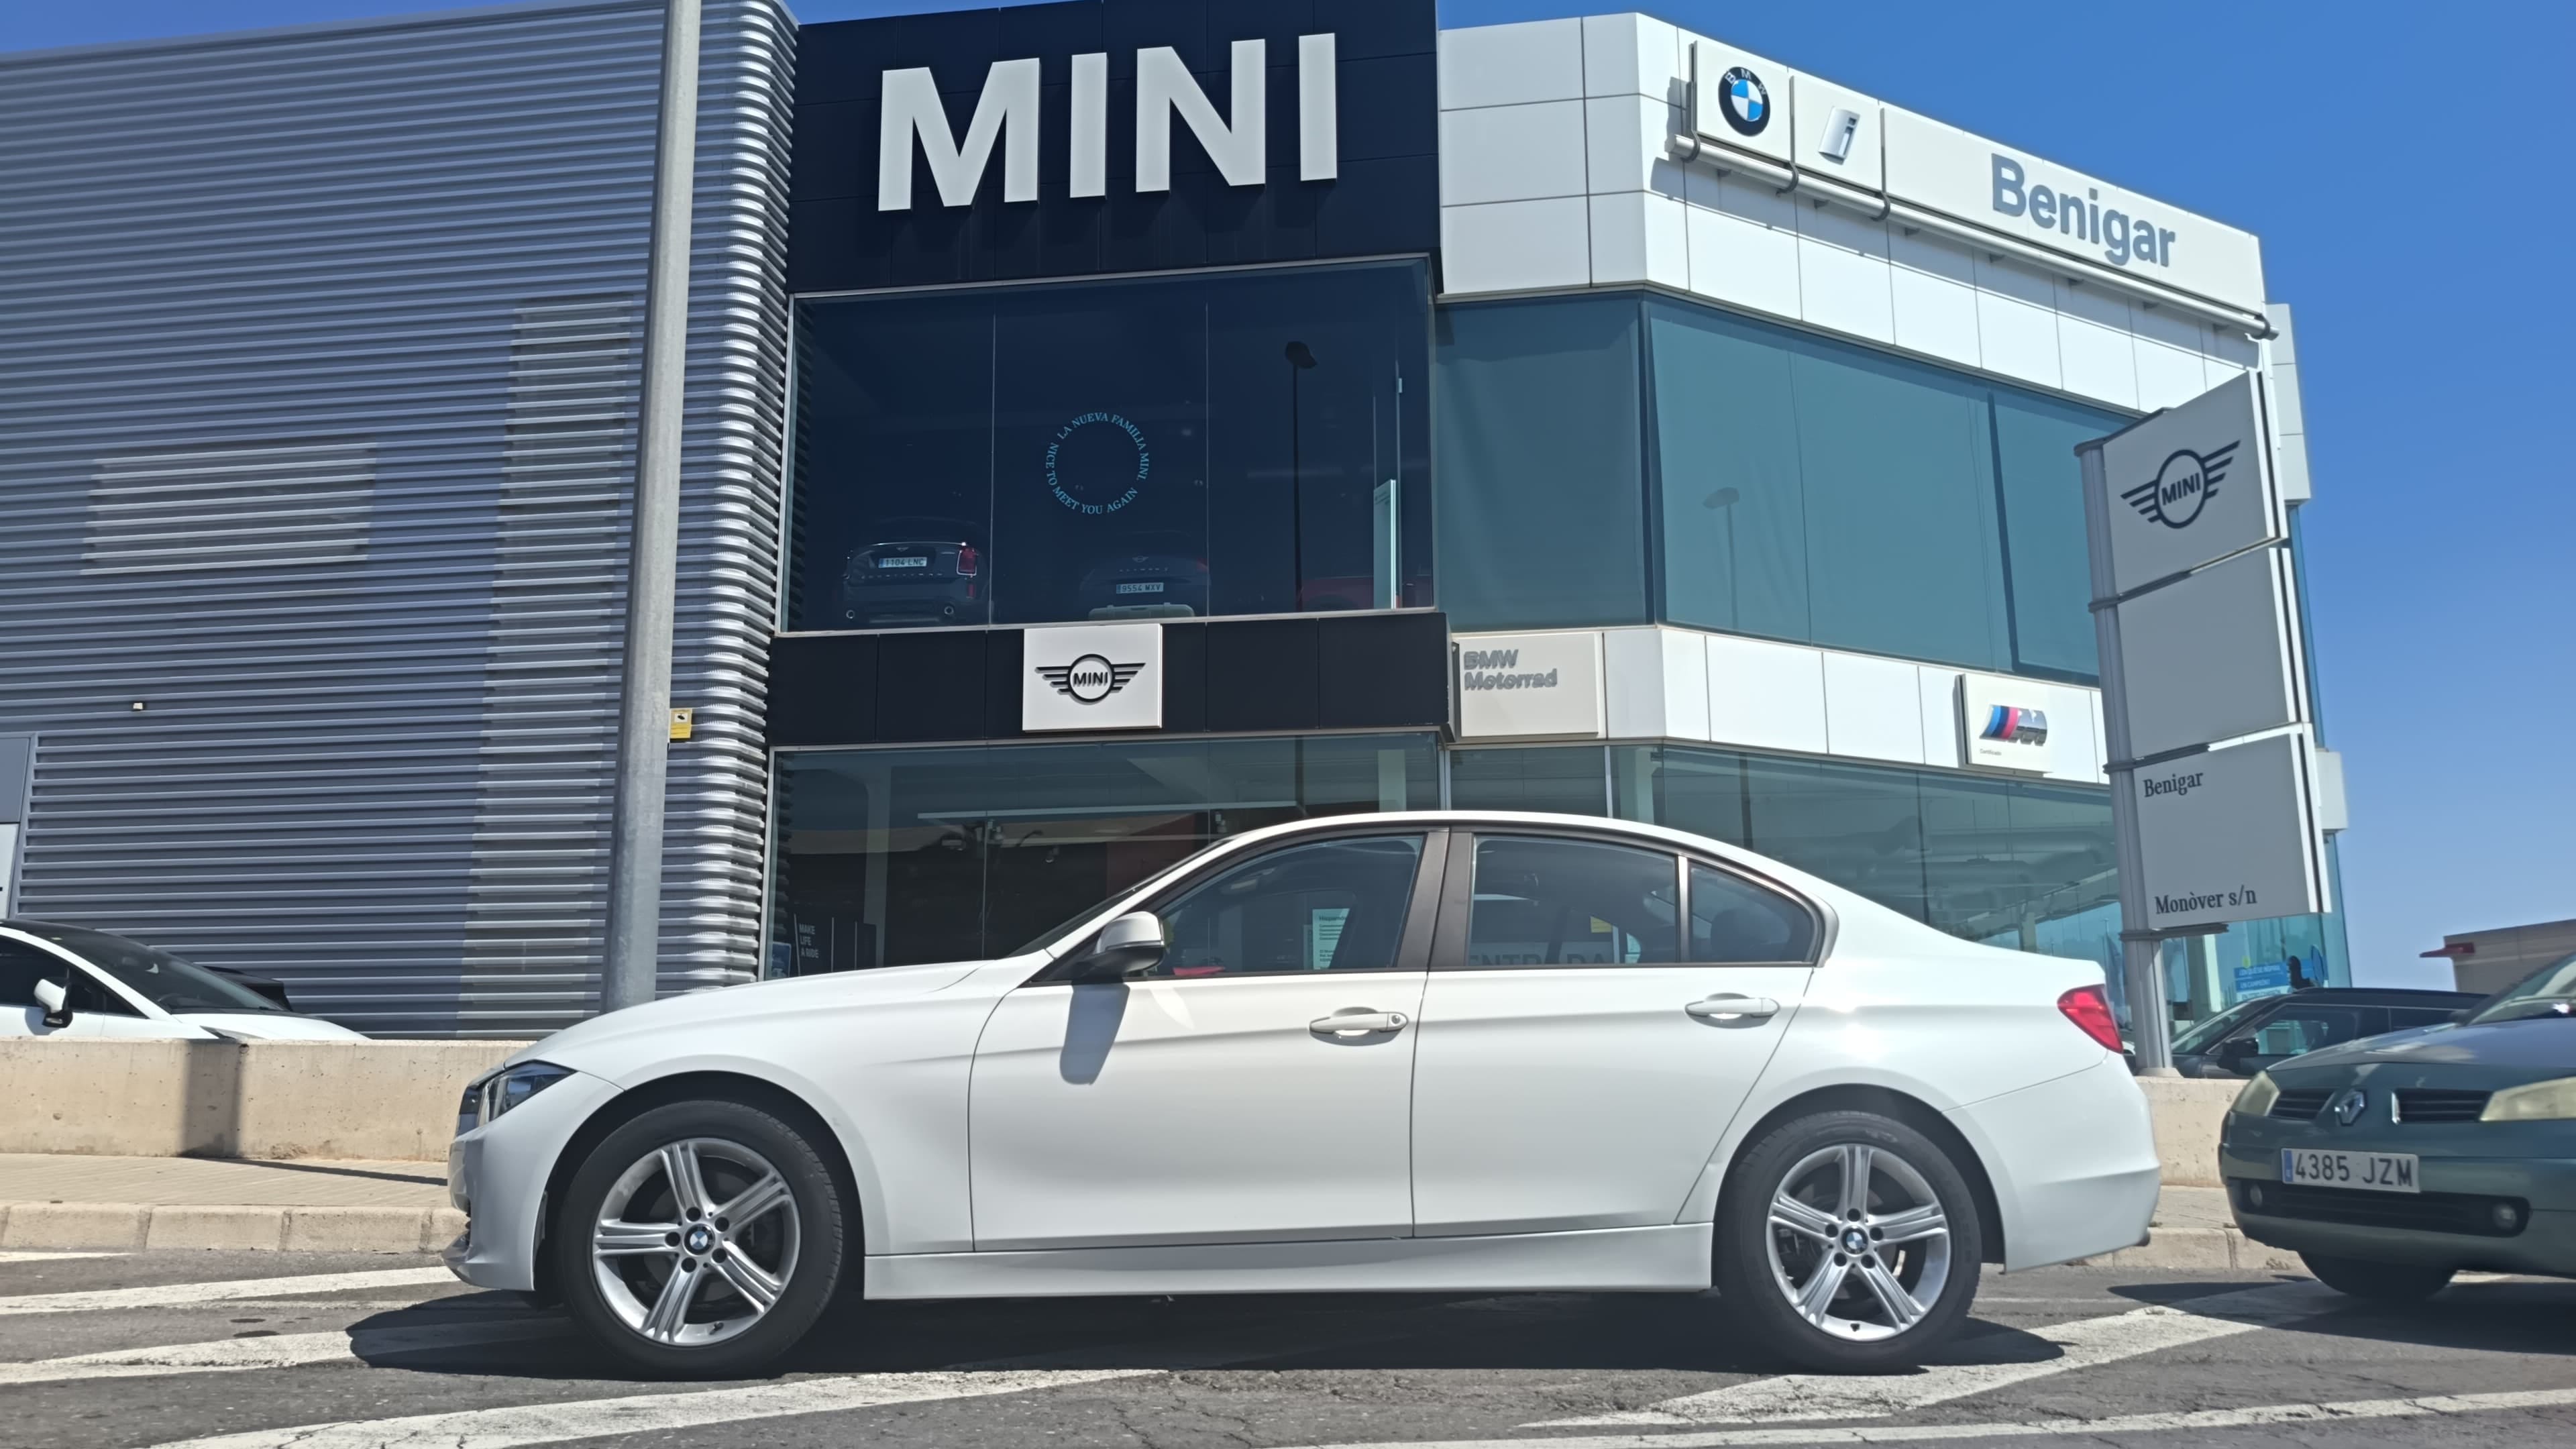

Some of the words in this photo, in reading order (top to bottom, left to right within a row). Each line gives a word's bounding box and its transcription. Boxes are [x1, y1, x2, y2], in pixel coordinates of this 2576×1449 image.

[877, 32, 1338, 211] MINI
[1990, 152, 2176, 268] Benigar
[1057, 425, 1072, 439] LA
[1071, 412, 1109, 428] NUEVA
[1111, 414, 1146, 451] FAMILIA
[1046, 442, 1059, 469] NICE
[1046, 470, 1058, 486] TO
[2161, 472, 2202, 506] MINI
[1052, 486, 1080, 511] MEET
[1081, 504, 1103, 515] YOU
[1107, 487, 1138, 513] AGAIN
[885, 558, 906, 566] 1104
[908, 557, 924, 566] LNC
[1122, 584, 1142, 592] 9554
[1463, 649, 1519, 670] BMW
[1073, 672, 1108, 686] MINI
[1464, 668, 1558, 690] Motorrad
[2143, 773, 2204, 798] Benigar
[2154, 891, 2224, 915] Monòver
[2228, 884, 2257, 906] s/n
[799, 924, 816, 934] MAKE
[800, 935, 812, 946] LIFE
[2295, 1152, 2350, 1181] 4385
[2362, 1157, 2413, 1187] JZM
